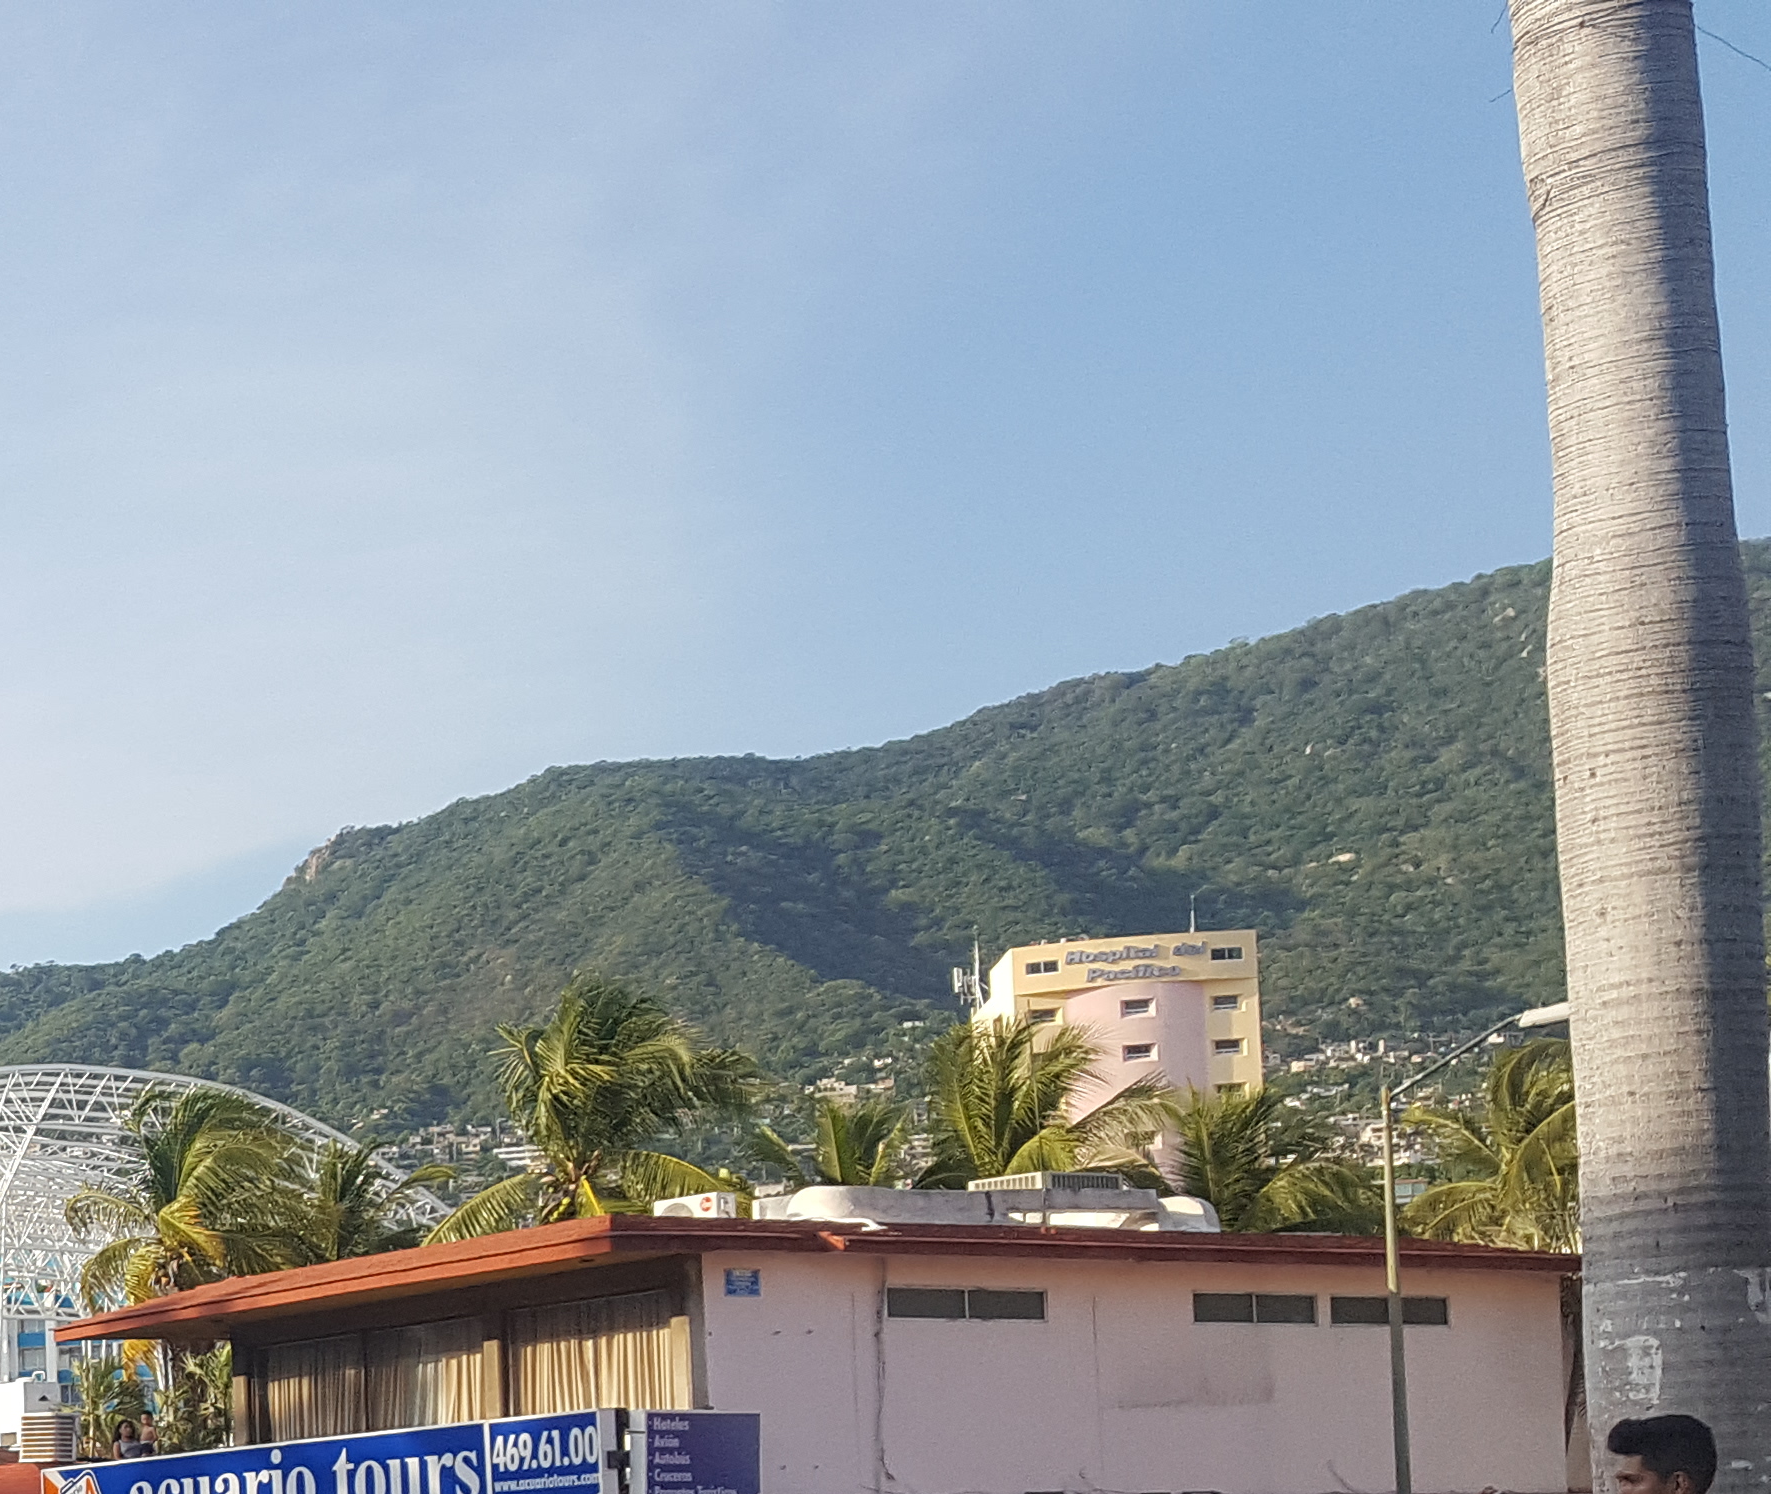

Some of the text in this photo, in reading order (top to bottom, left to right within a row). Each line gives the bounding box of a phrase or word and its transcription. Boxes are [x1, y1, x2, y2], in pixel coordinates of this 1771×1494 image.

[1065, 940, 1209, 965] Hospital del
[653, 1416, 690, 1431] Hoteles
[492, 1425, 598, 1473] 469.61.00
